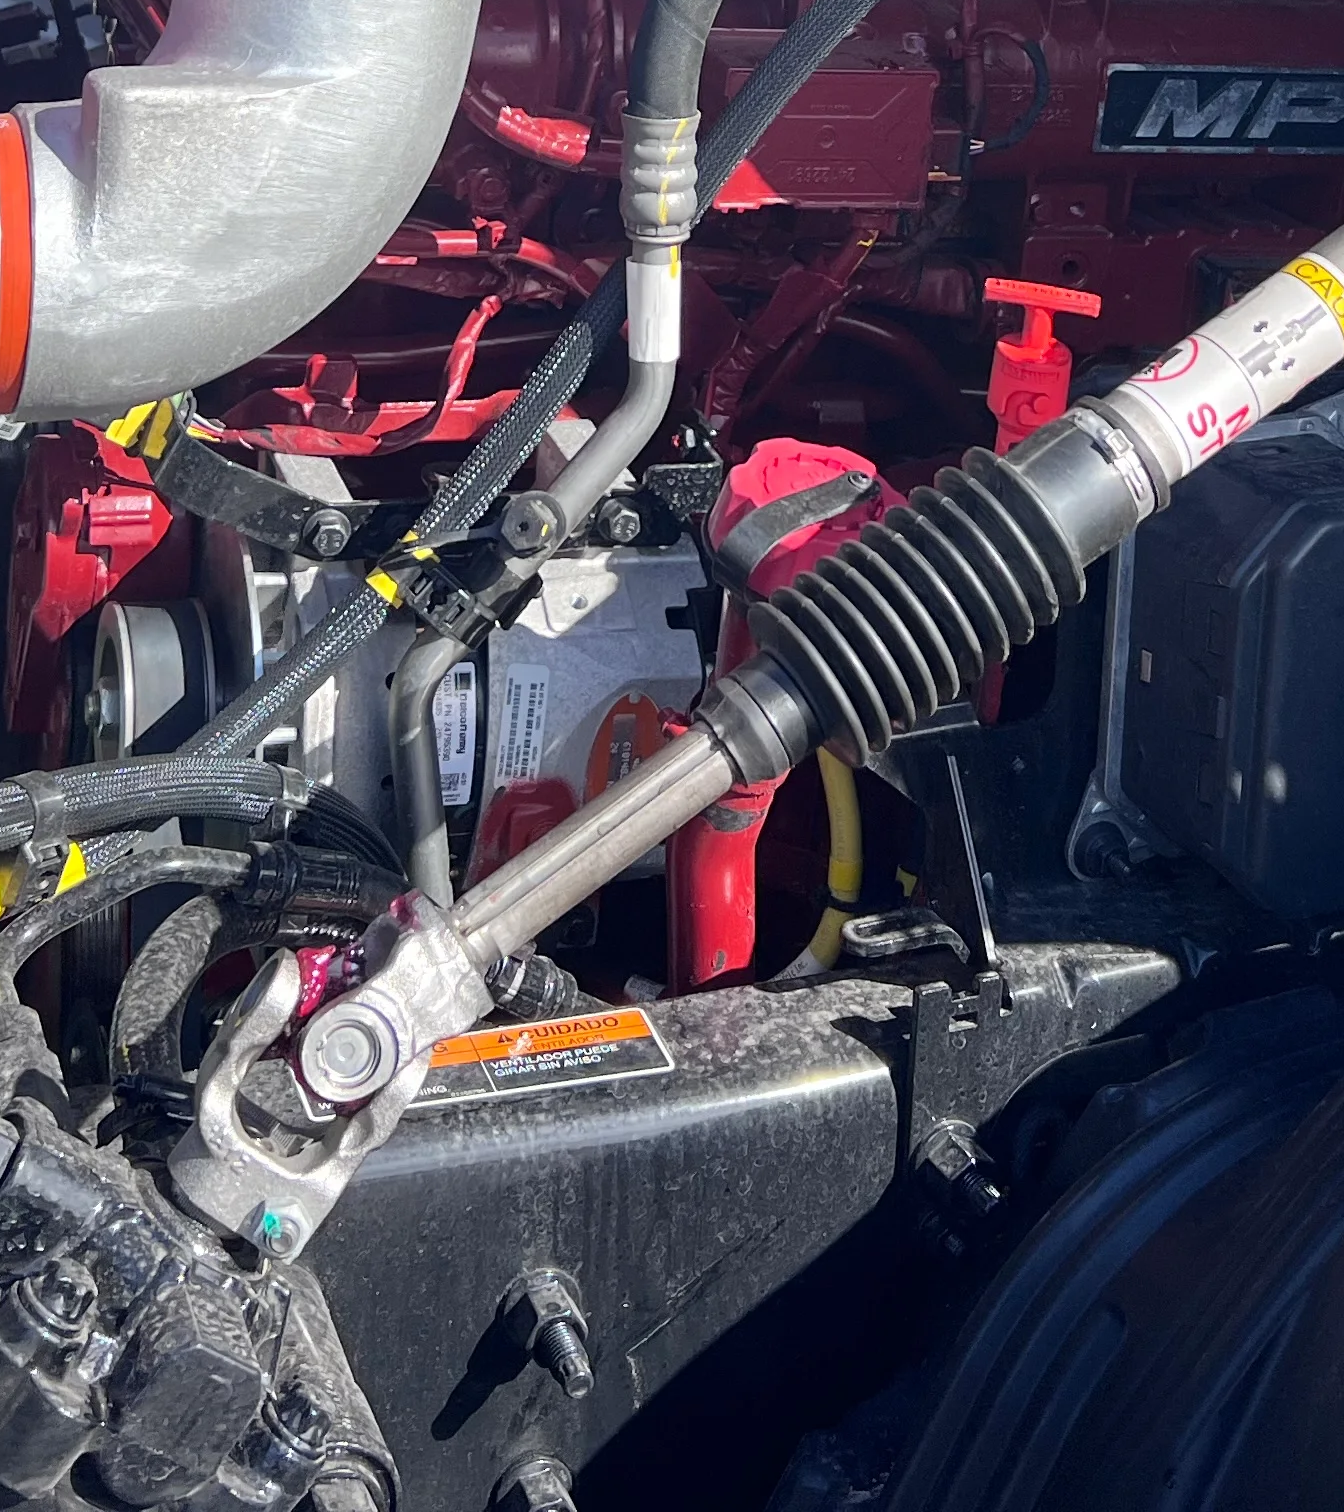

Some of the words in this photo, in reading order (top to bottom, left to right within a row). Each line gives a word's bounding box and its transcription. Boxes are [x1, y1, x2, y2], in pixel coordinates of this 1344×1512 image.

[519, 1017, 618, 1039] CUIDADO
[525, 1034, 604, 1052] VENTILADOR
[490, 1048, 575, 1069] VENTILADOR
[576, 1044, 619, 1057] PUEDE
[494, 1064, 536, 1077] GIRAR
[538, 1061, 562, 1072] SIN
